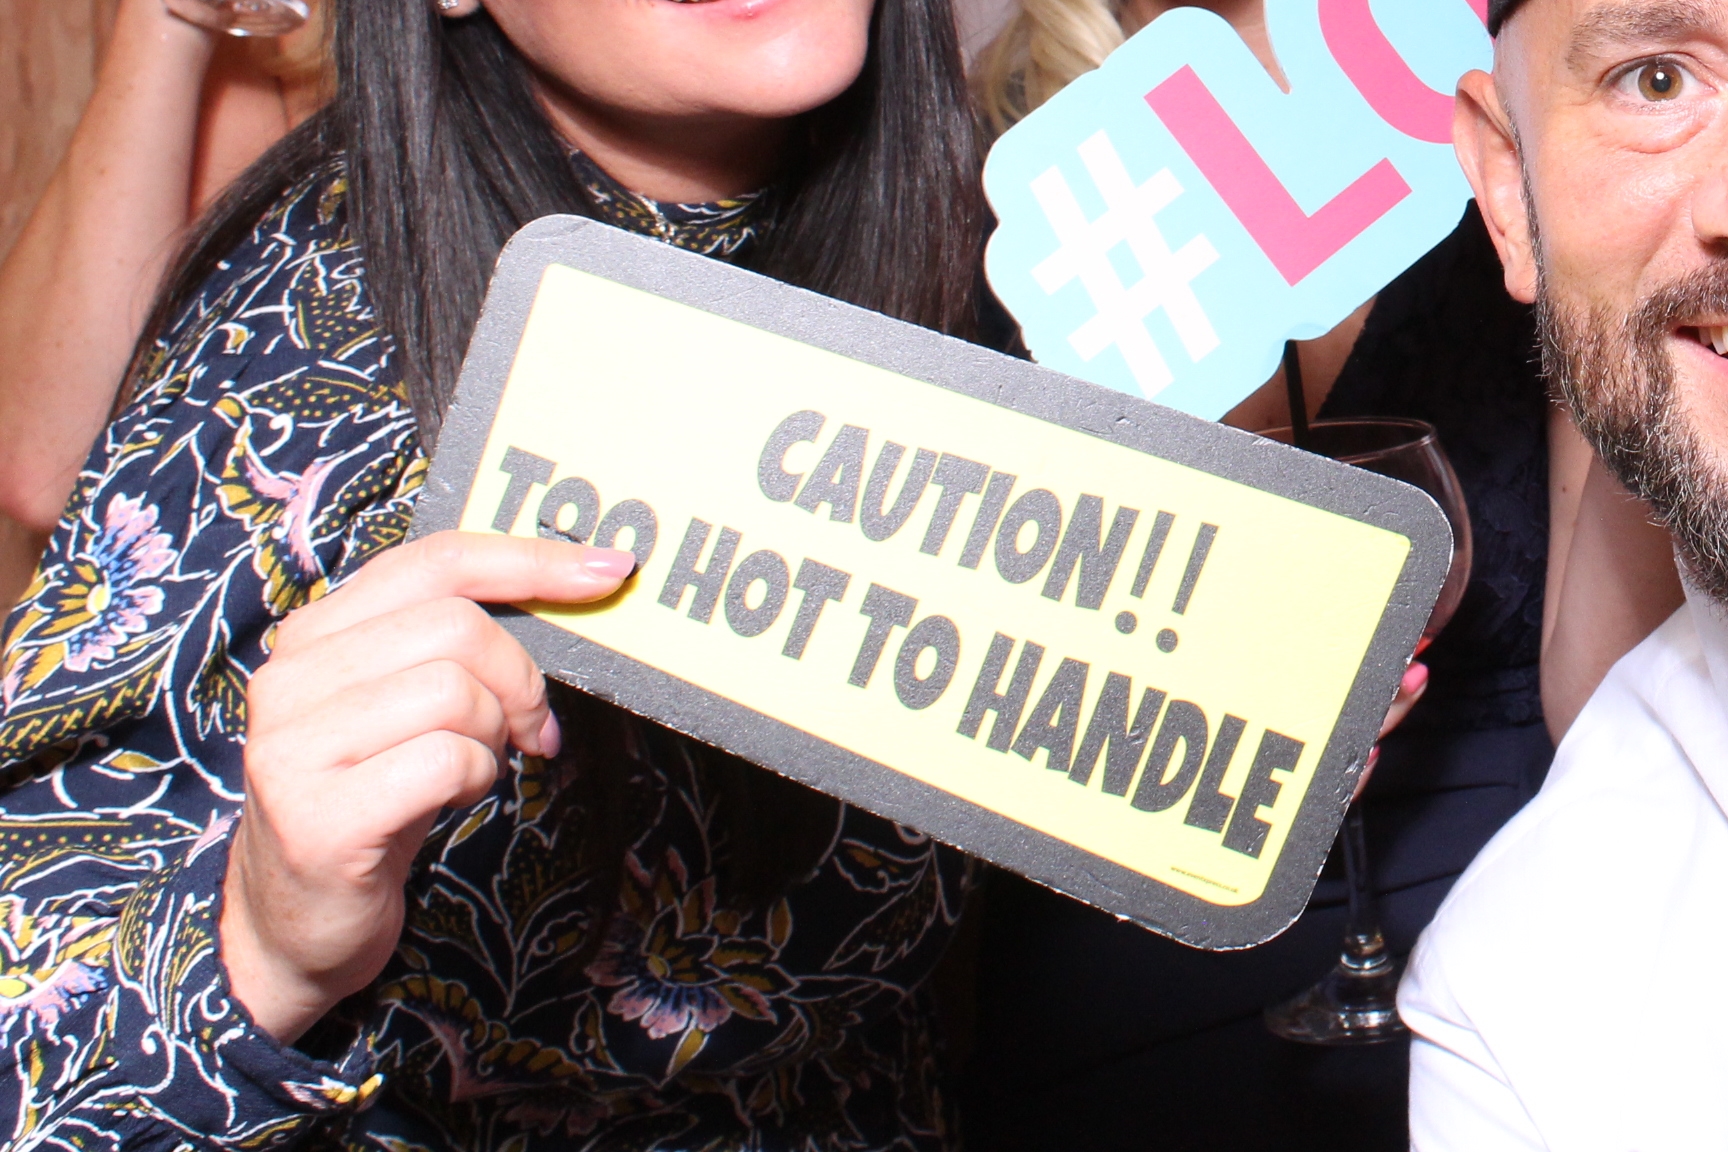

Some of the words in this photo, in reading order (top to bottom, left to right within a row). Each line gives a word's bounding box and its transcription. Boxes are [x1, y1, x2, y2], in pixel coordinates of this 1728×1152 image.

[490, 445, 659, 580] TOO
[656, 517, 851, 660] HOT
[847, 582, 961, 711] TO
[956, 632, 1306, 860] HANDLE
[756, 408, 1219, 654] CAUTION!!
